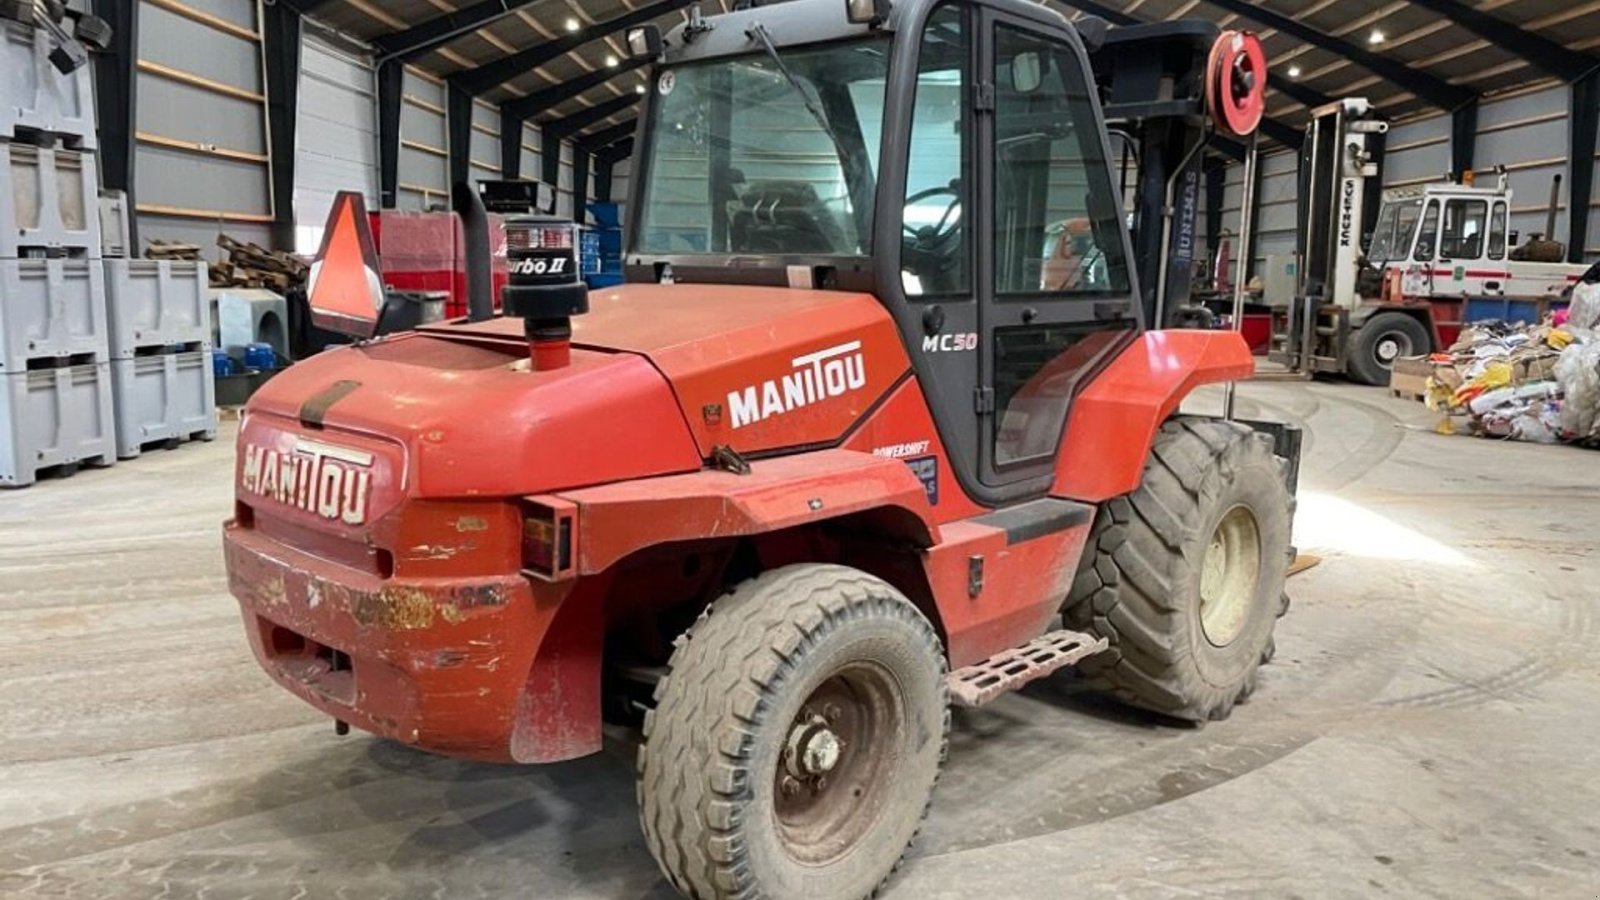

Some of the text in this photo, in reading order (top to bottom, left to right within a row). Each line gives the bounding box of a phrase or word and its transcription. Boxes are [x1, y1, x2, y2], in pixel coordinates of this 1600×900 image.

[1340, 180, 1354, 246] SVETRUCK
[507, 258, 547, 274] urbo
[922, 333, 977, 352] MC50
[727, 340, 866, 429] MANITOU
[872, 440, 930, 458] POWERSHIFT
[243, 440, 373, 524] MANITOU
